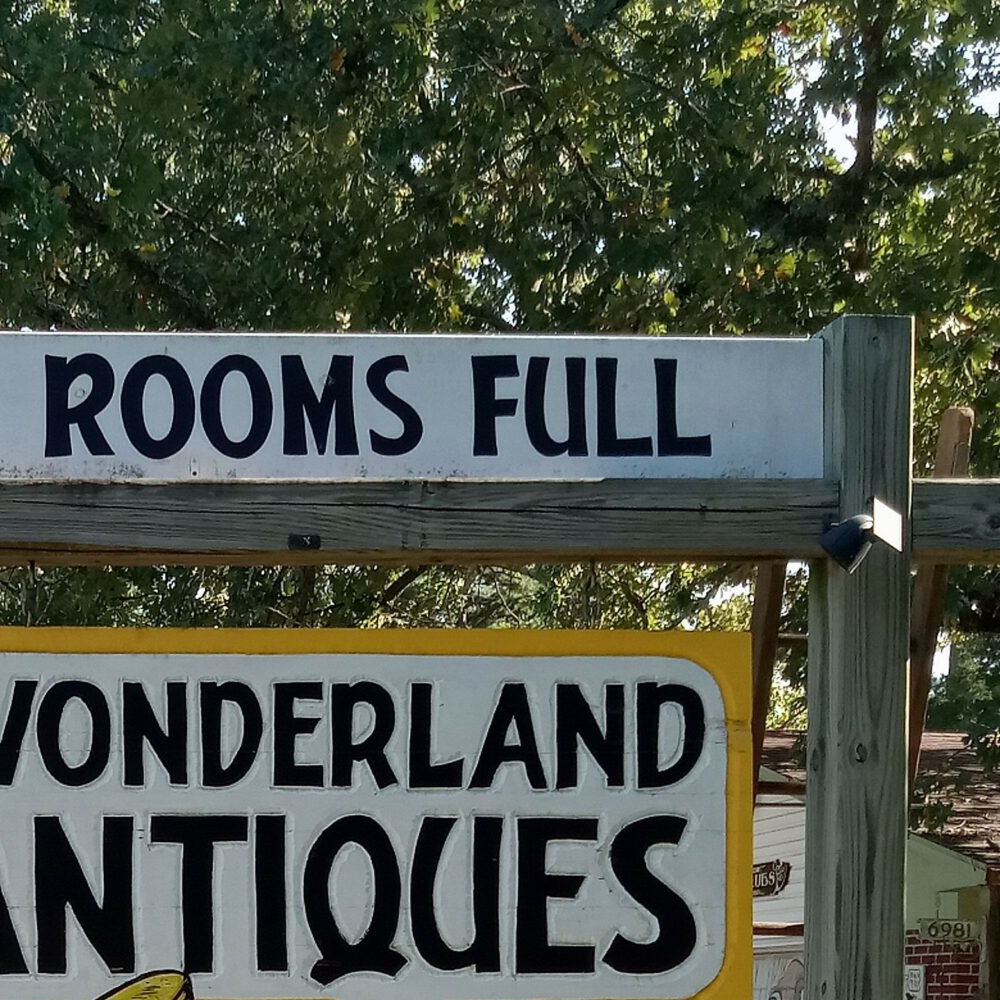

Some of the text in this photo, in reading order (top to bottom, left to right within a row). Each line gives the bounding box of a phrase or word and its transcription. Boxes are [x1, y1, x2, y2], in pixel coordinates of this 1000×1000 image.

[44, 353, 424, 459] ROOMS
[471, 354, 712, 457] FULL
[927, 921, 971, 938] 6981
